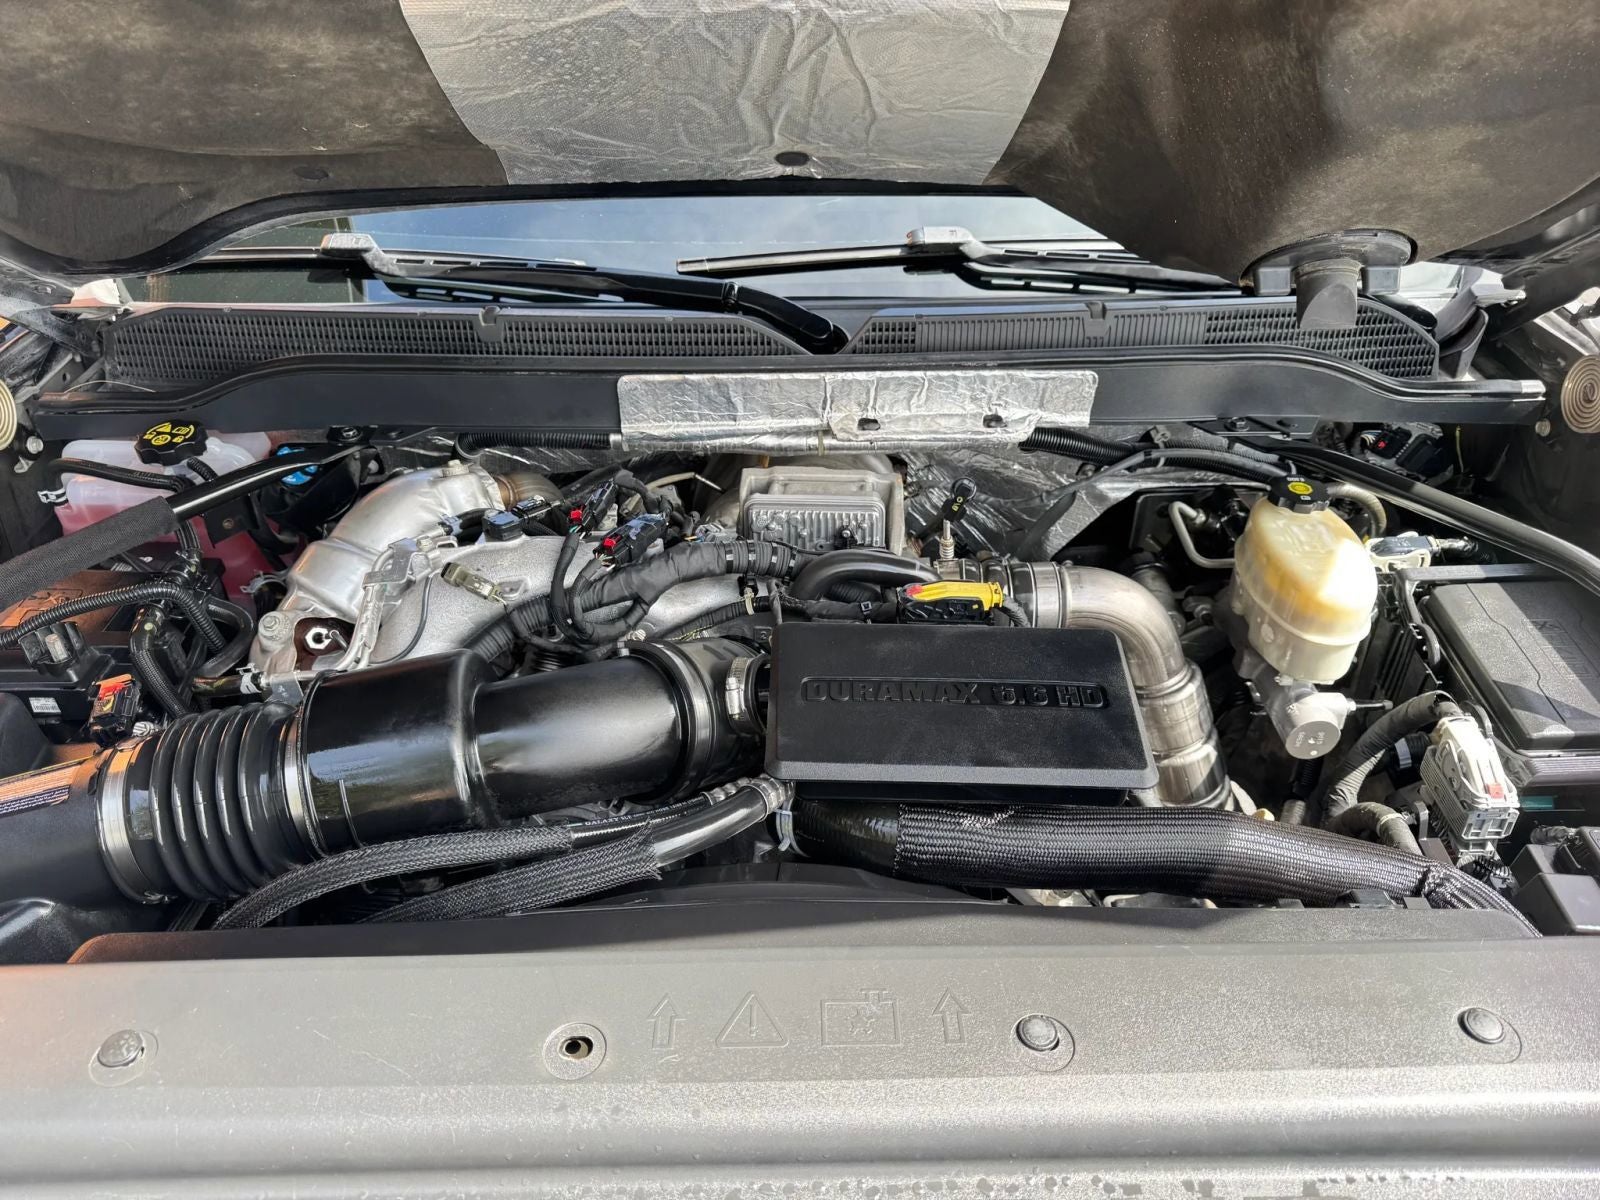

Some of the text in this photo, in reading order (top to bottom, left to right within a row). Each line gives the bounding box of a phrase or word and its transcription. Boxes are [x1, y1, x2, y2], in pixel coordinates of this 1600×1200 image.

[804, 680, 981, 705] DURAMAX
[1054, 684, 1104, 709] HD
[584, 815, 619, 826] GALAXY
